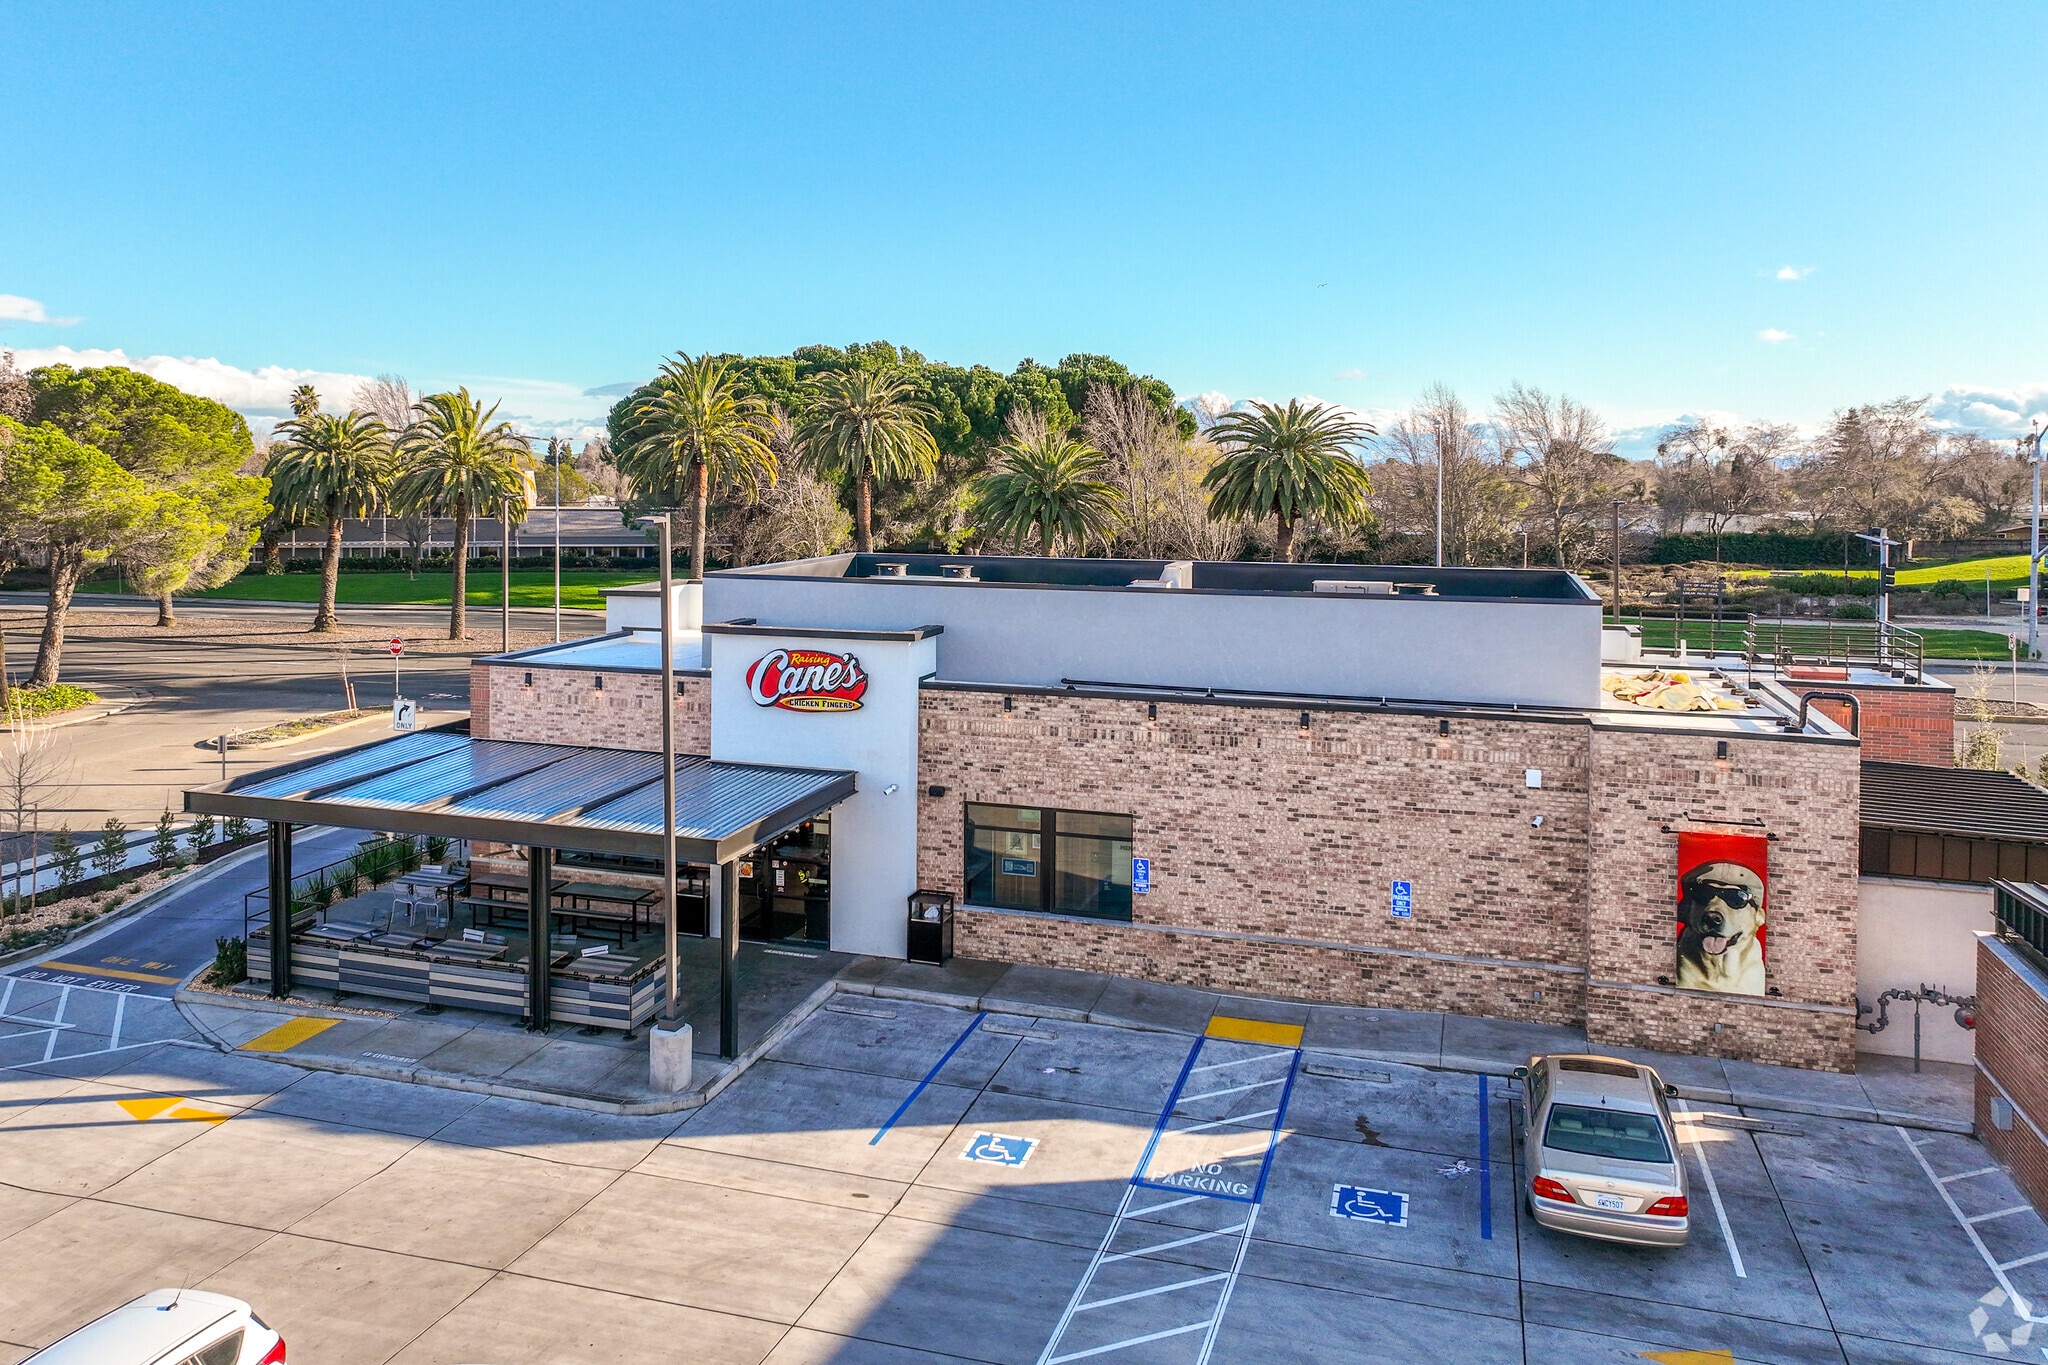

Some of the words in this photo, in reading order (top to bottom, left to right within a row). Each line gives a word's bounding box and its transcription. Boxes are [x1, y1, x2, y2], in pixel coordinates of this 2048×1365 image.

[791, 653, 830, 666] Raising
[751, 649, 865, 706] Cane's
[789, 699, 820, 707] CHICKEN
[822, 700, 854, 709] FINGERS
[101, 956, 139, 966] ONE
[21, 971, 48, 980] DO
[48, 974, 87, 985] NOT
[85, 980, 141, 992] ENTER
[1191, 1161, 1223, 1175] NO
[1150, 1170, 1248, 1195] PARKING
